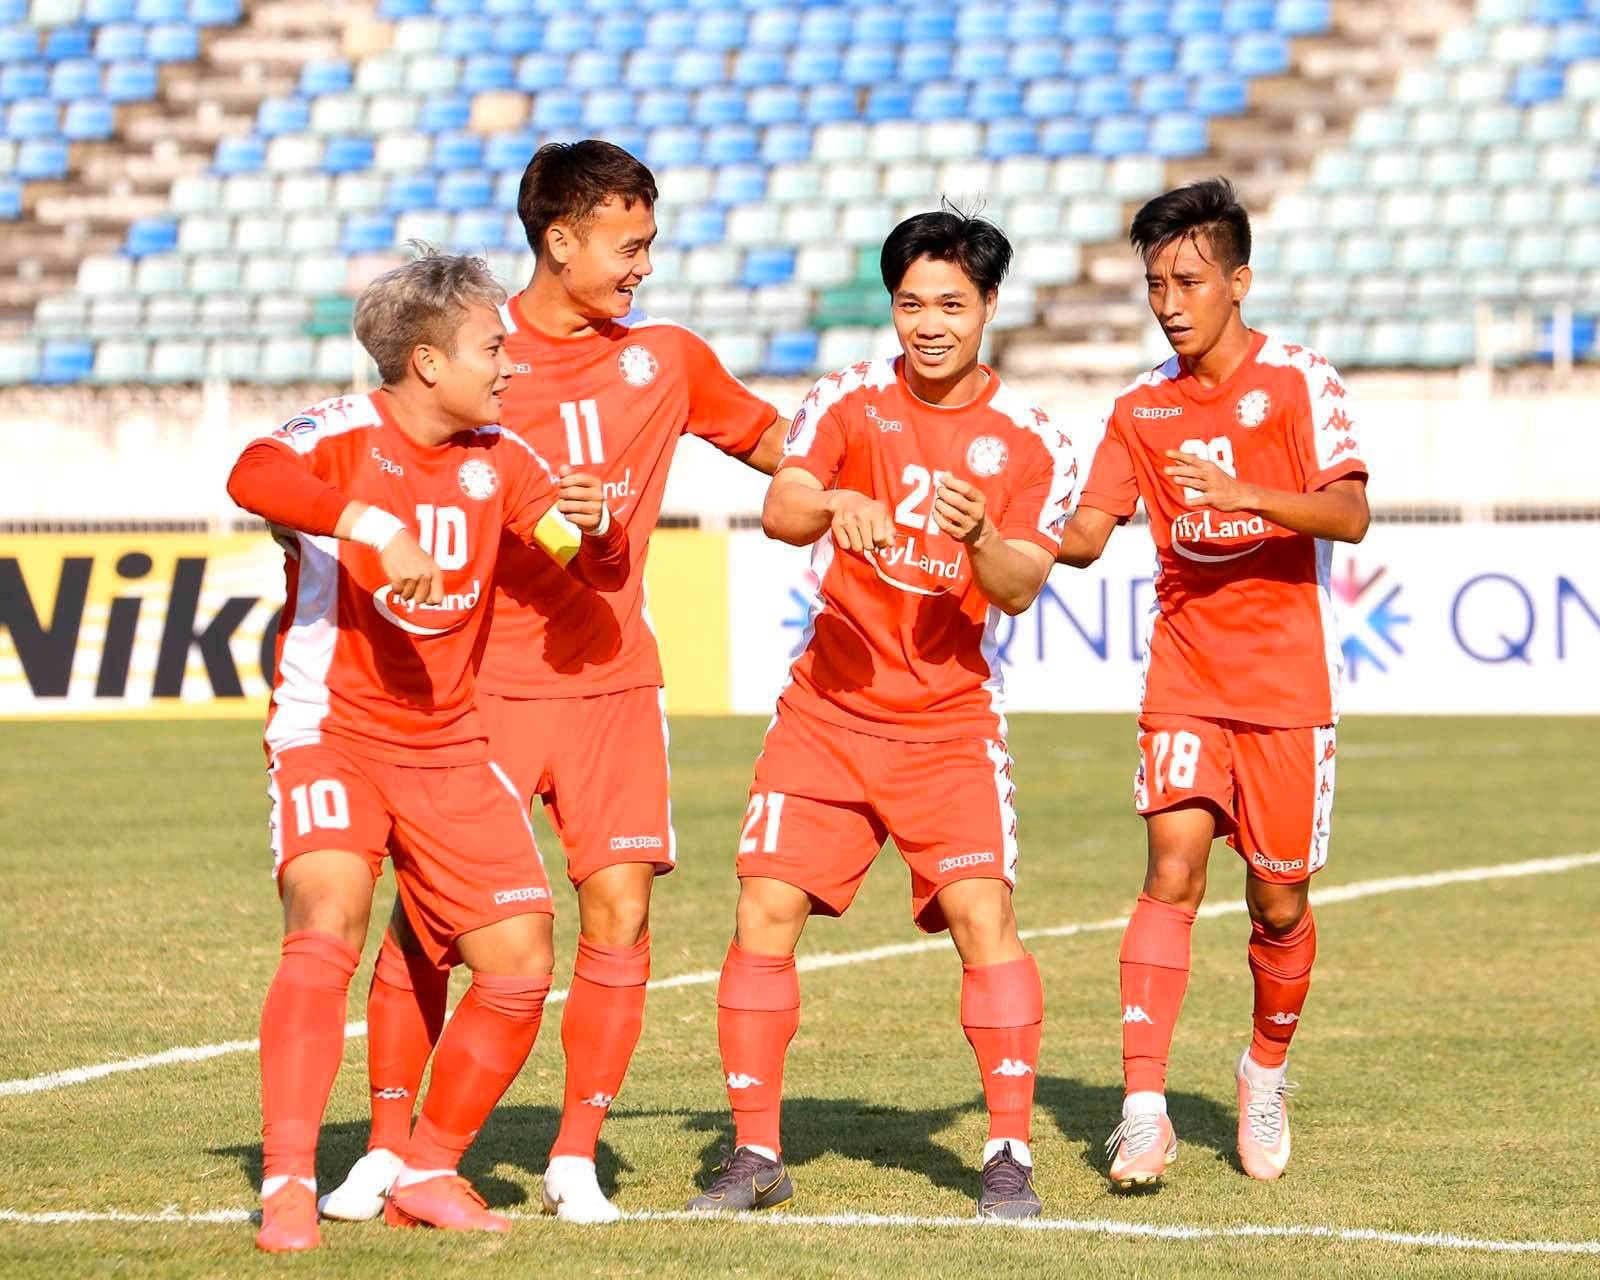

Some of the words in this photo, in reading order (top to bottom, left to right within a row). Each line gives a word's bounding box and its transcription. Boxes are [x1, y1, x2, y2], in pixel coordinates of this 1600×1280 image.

[560, 399, 605, 466] 11
[1133, 406, 1183, 420] Kappa
[415, 504, 468, 571] 10
[0, 552, 284, 698] Nik
[290, 779, 351, 836] 10
[738, 791, 785, 853] 21
[610, 836, 662, 850] Kappa
[938, 851, 995, 872] Kappa
[1253, 852, 1304, 872] Kappa
[495, 887, 547, 904] Kappa
